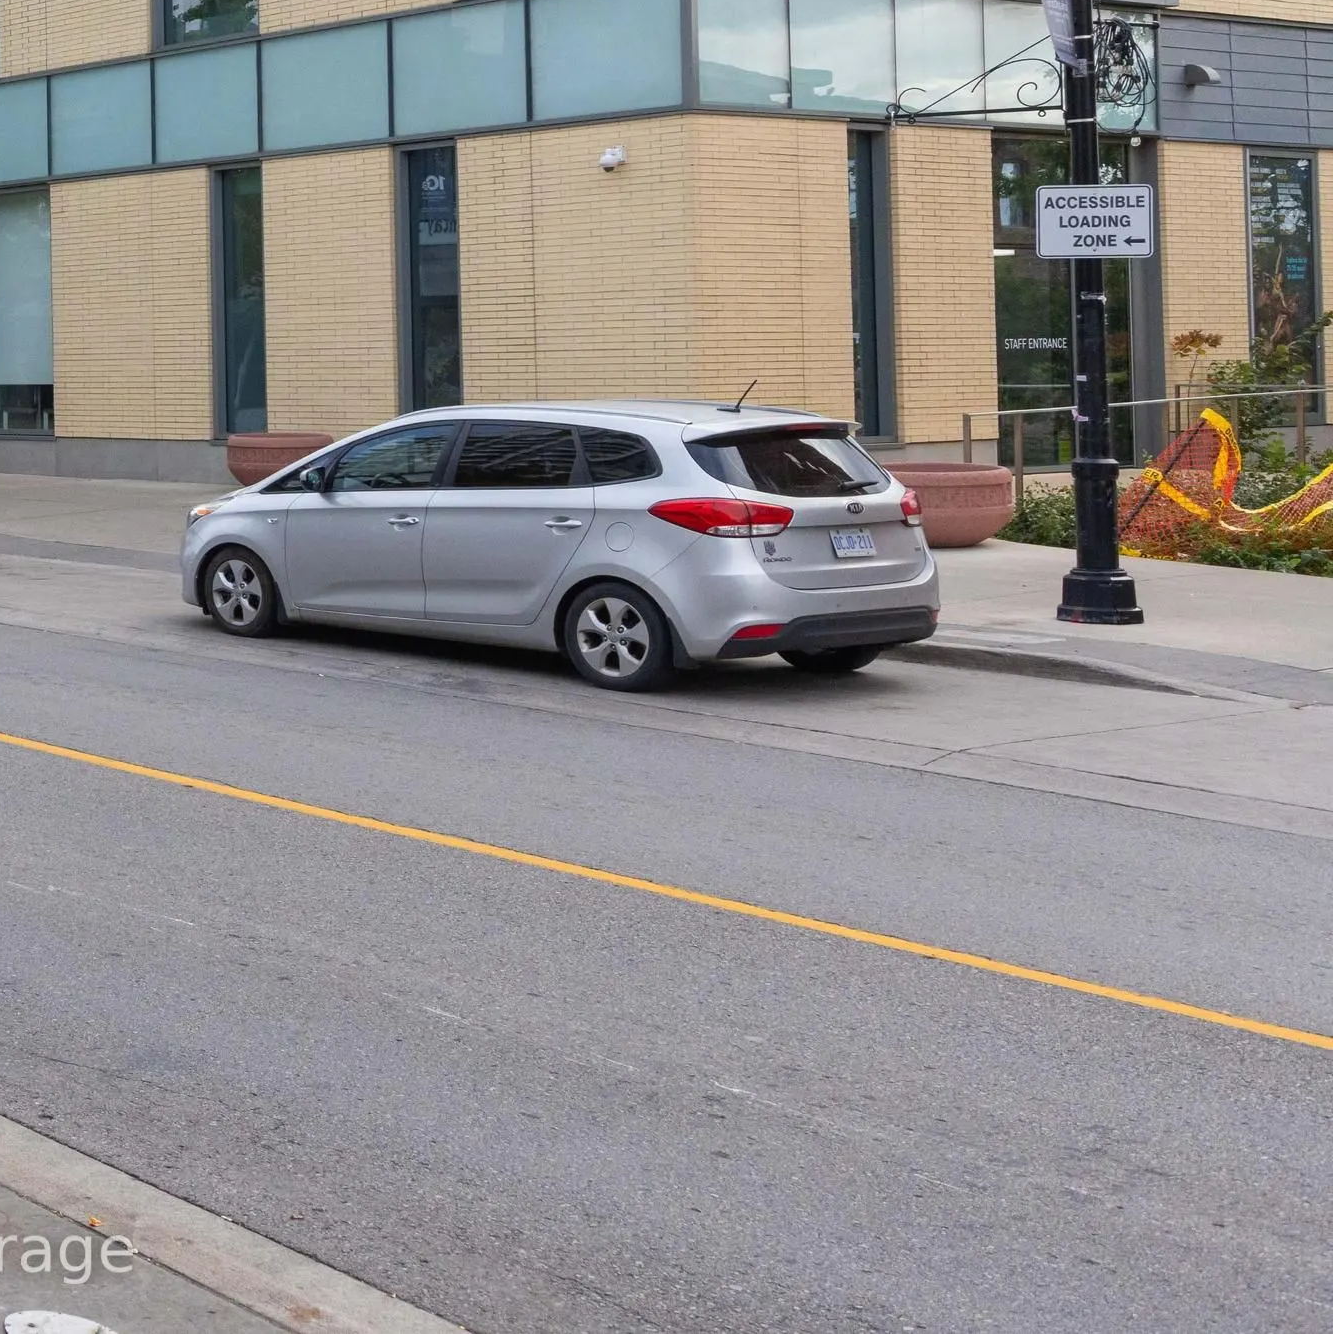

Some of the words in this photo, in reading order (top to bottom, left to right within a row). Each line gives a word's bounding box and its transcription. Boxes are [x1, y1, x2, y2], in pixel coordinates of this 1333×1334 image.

[1044, 195, 1145, 209] ACCESSIBLE
[1059, 215, 1131, 228] LOADING
[1073, 234, 1117, 247] ZONE
[1004, 338, 1027, 349] STAFF
[1028, 337, 1067, 349] ENTRANCE
